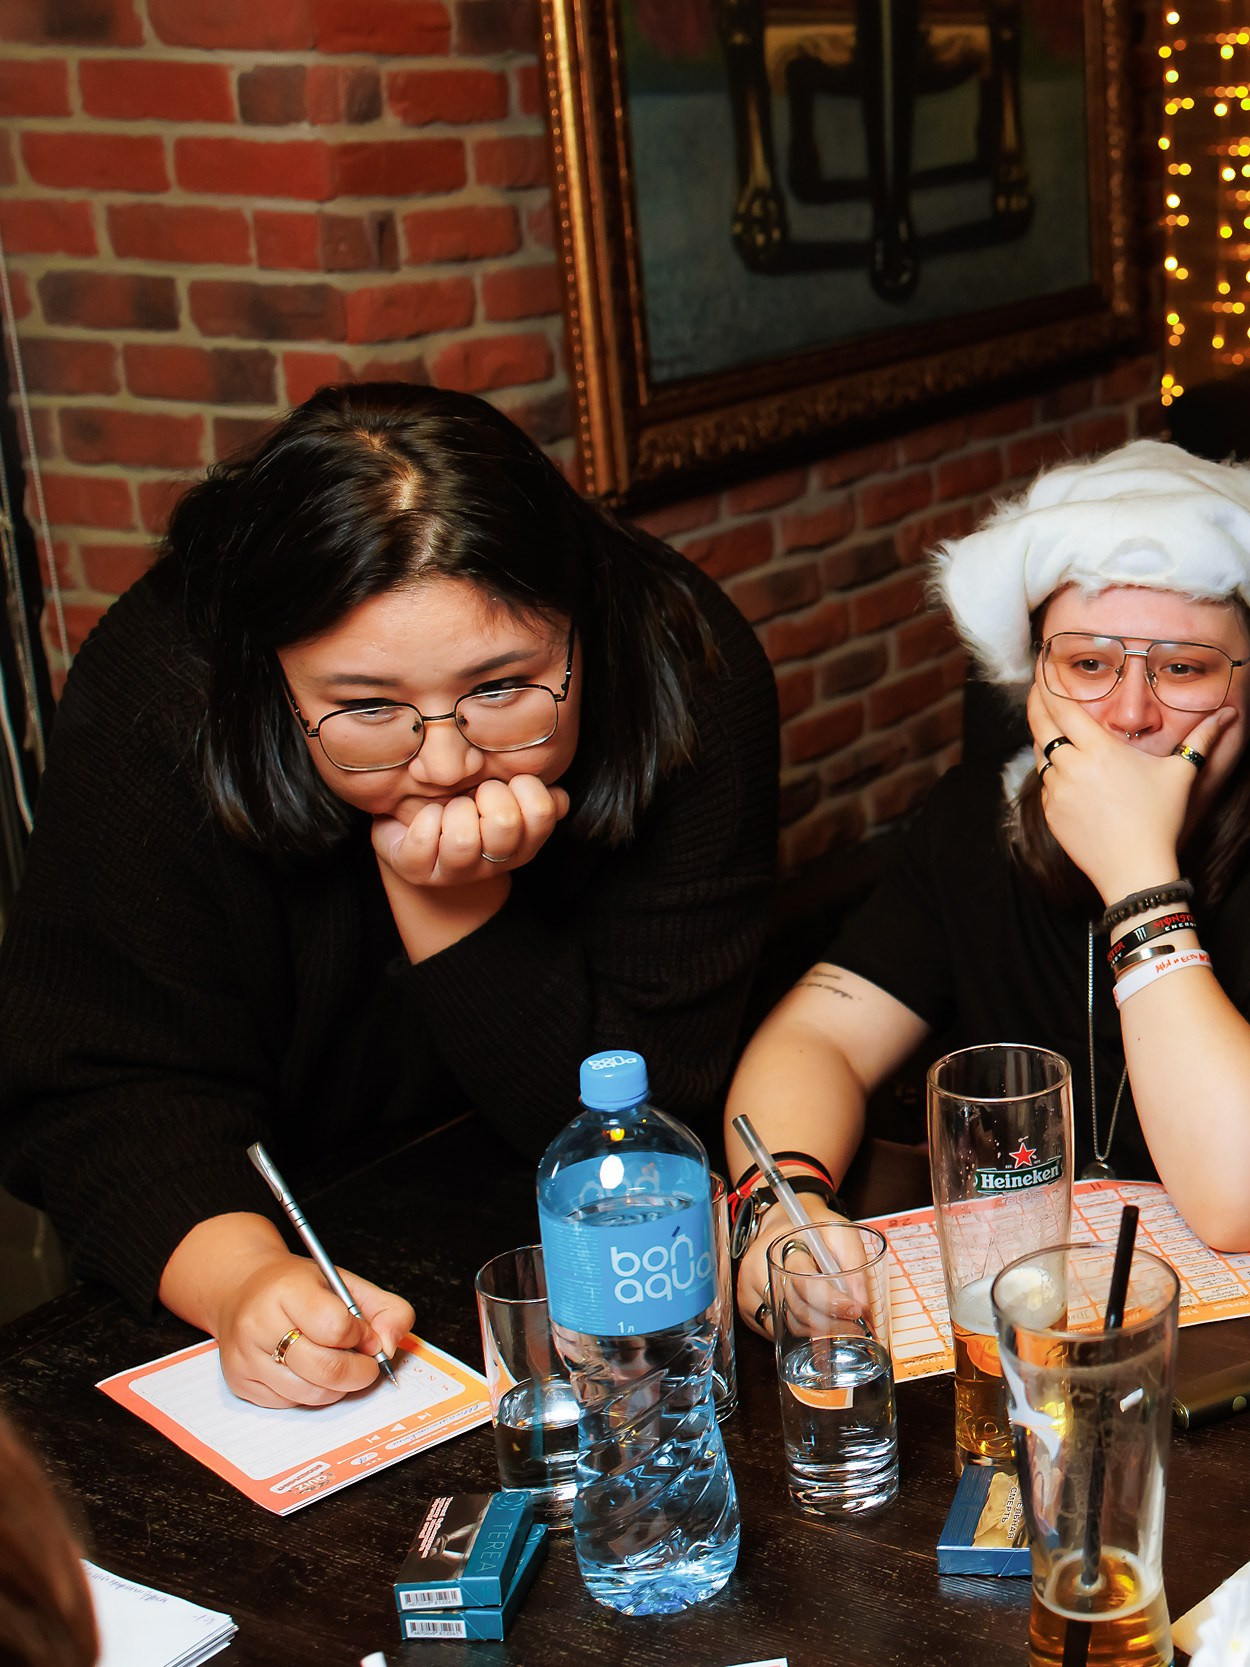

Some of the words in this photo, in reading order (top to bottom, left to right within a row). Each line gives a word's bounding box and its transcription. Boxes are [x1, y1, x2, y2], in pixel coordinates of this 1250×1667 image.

[980, 1165, 1059, 1189] Heineken
[617, 1322, 625, 1334] 1
[1001, 1486, 1018, 1524] СМЕРТЬ
[475, 1521, 513, 1574] TEREA
